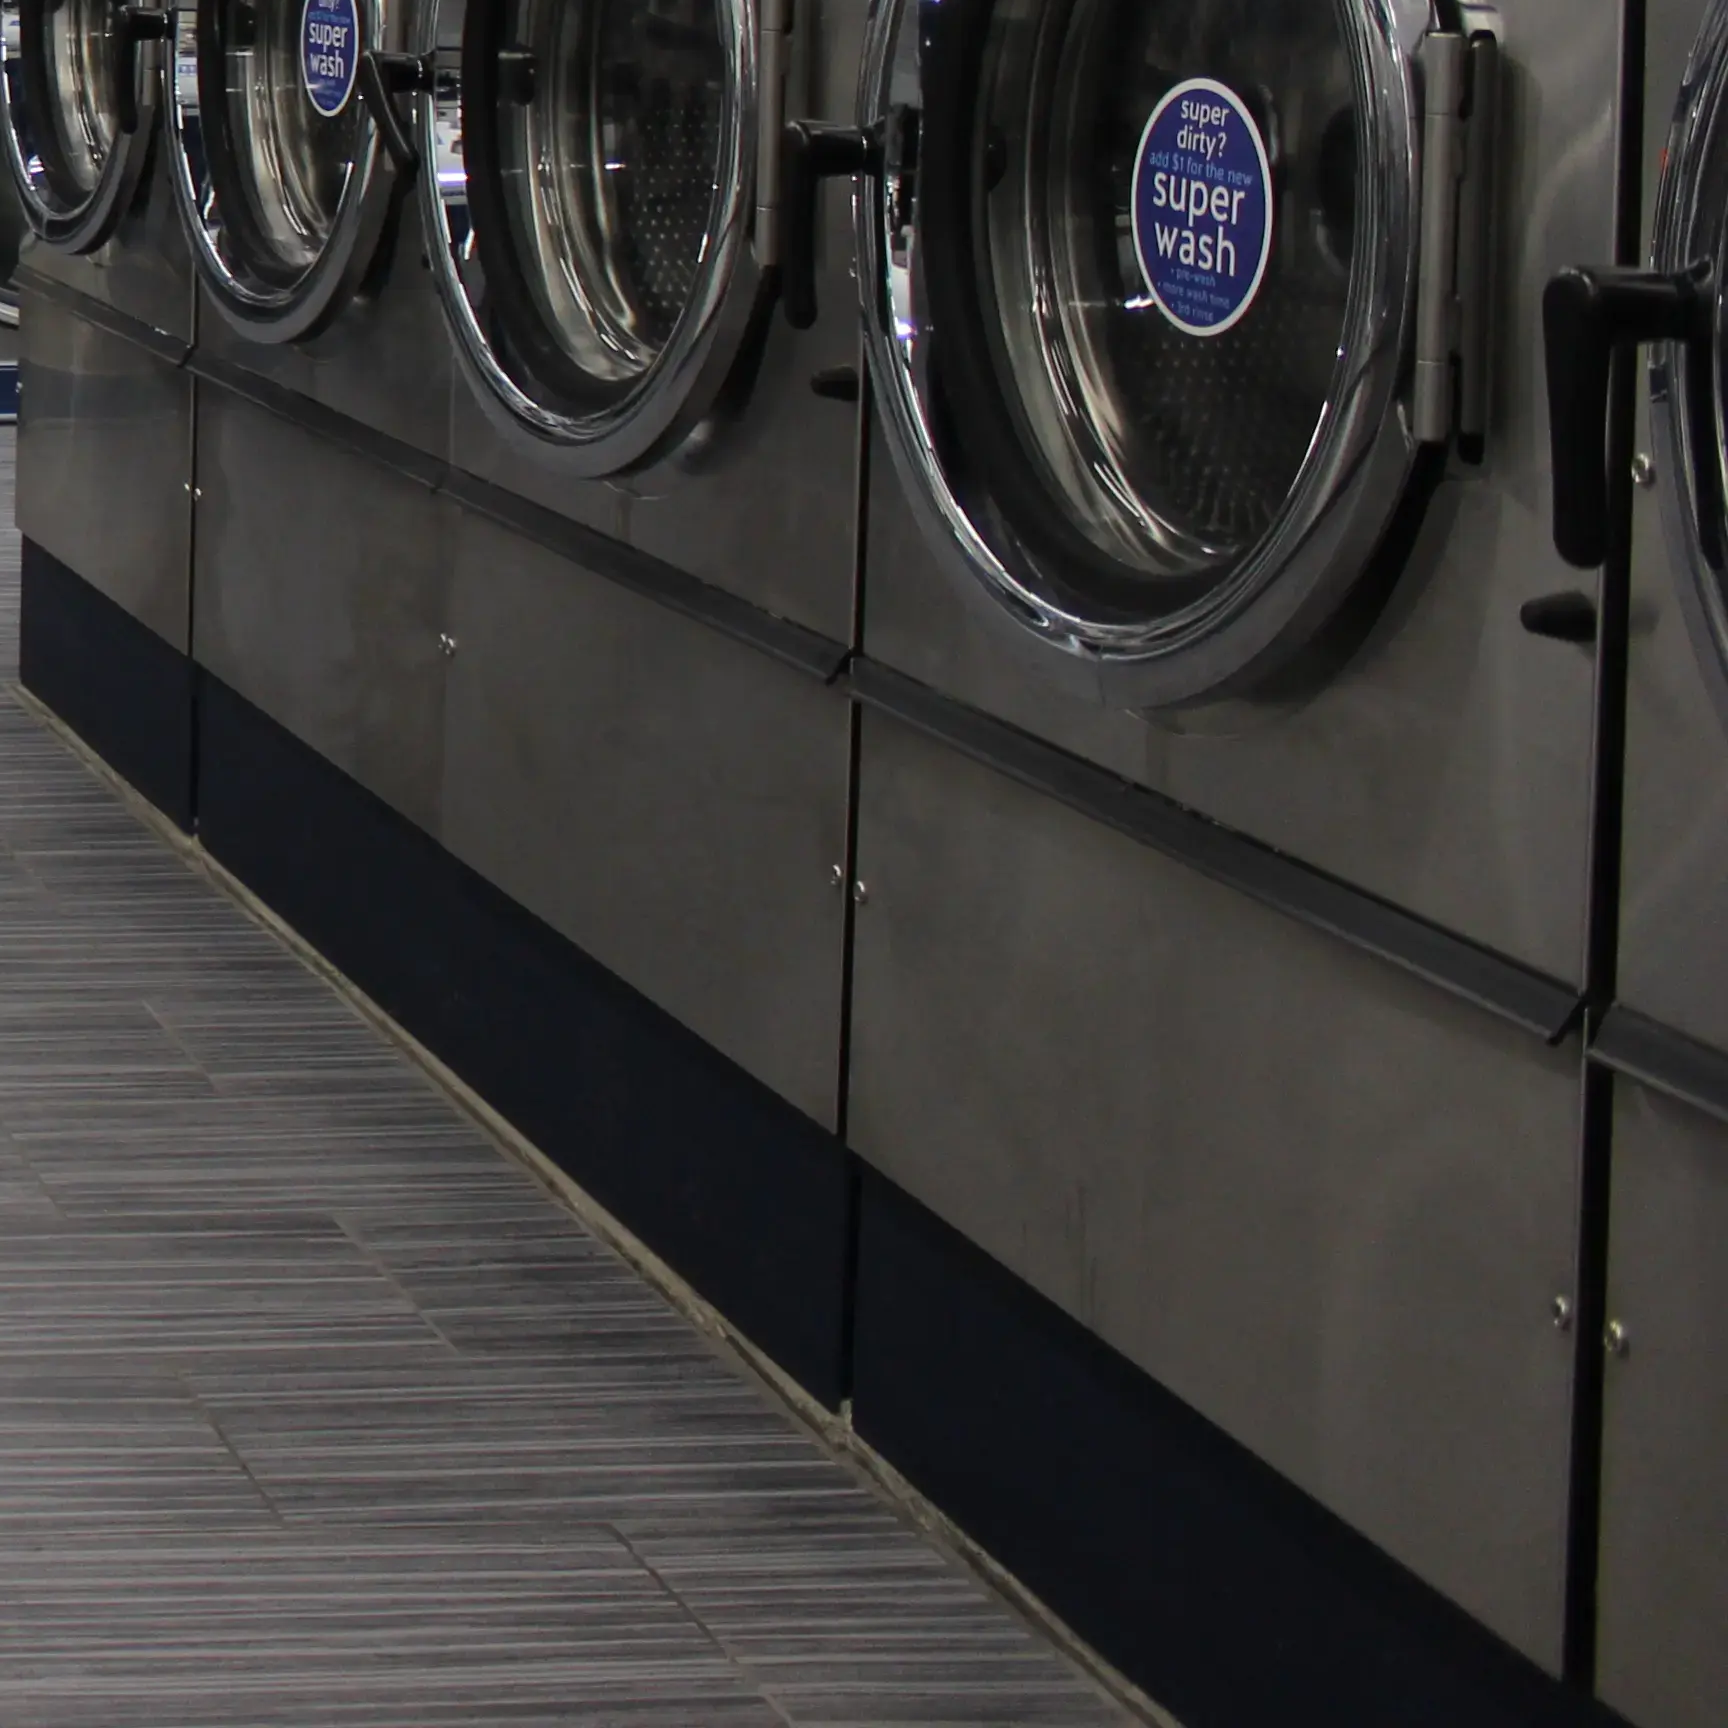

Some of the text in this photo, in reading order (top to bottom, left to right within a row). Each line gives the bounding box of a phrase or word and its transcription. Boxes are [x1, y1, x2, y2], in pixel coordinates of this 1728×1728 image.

[309, 23, 348, 52] super
[310, 50, 344, 78] wash
[1181, 99, 1230, 128] super
[1177, 125, 1227, 160] dirty?
[1149, 150, 1253, 186] add $1 for the new
[1153, 172, 1245, 227] super
[1155, 222, 1235, 277] wash
[1162, 281, 1184, 296] more
[1186, 287, 1207, 303] wash
